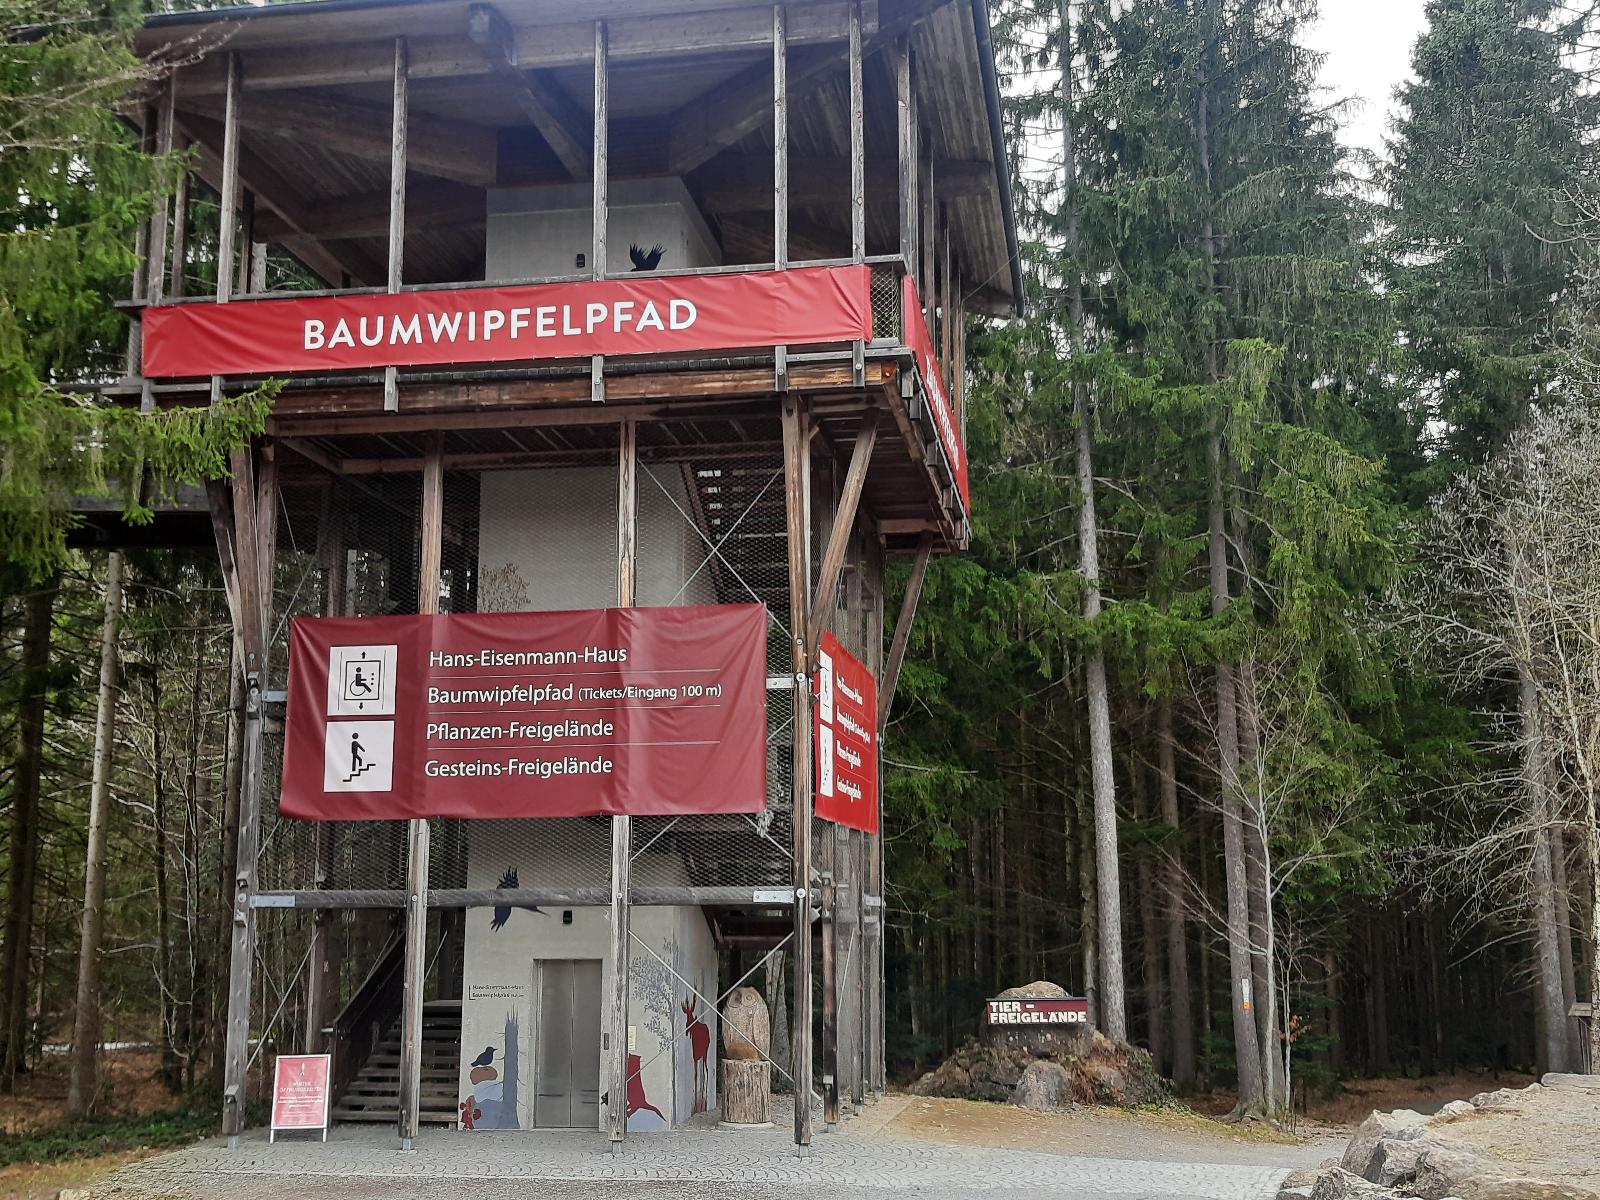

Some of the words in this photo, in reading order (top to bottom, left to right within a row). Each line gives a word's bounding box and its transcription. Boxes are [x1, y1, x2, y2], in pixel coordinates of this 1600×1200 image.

[303, 298, 698, 350] BAUMWIPFELPFAD
[429, 646, 628, 668] Hans-Eisenmann-Haus
[427, 683, 574, 706] Baumwipfelpfad
[578, 686, 678, 701] (Tickets/Eingang
[681, 685, 703, 697] 100
[705, 684, 723, 698] m)
[426, 719, 614, 741] Pflanzen-Freigelände
[424, 756, 613, 779] Gesteins-Freigelände
[990, 1011, 1087, 1024] FREIGELÄNDE
